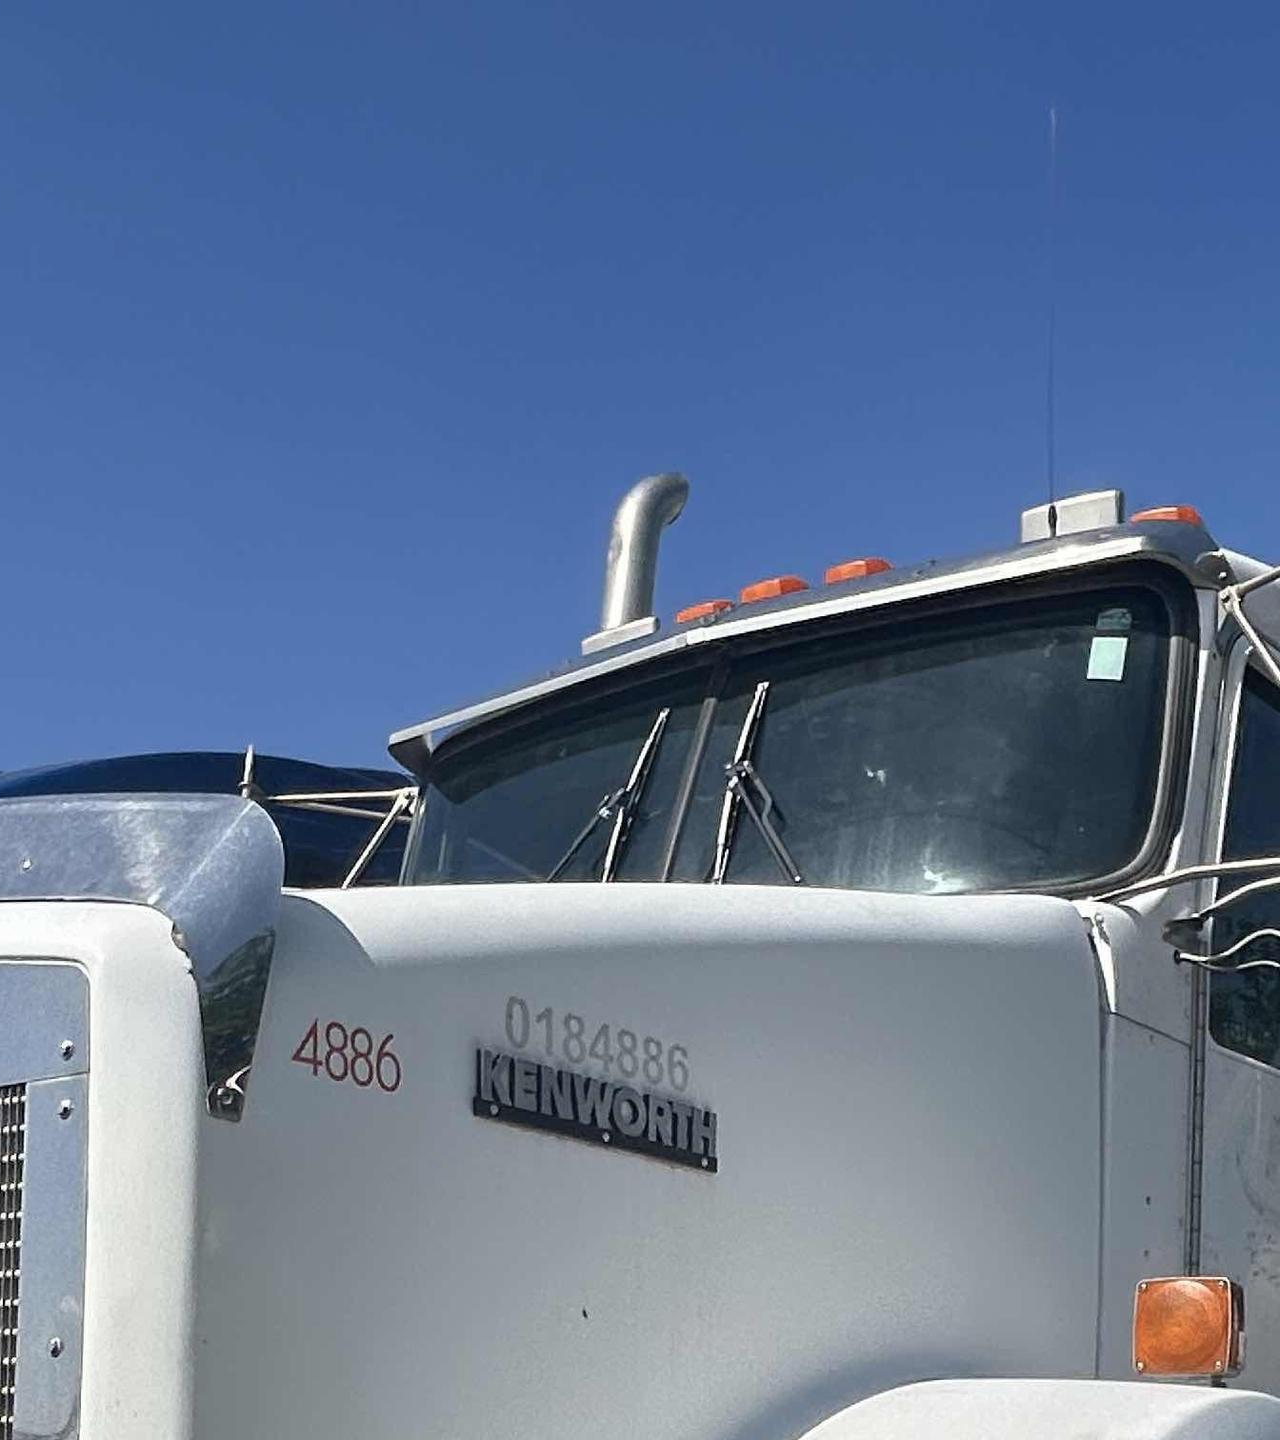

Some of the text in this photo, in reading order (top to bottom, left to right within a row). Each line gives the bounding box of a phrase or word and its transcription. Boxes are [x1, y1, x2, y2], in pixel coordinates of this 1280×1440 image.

[291, 1017, 401, 1092] 4886
[505, 996, 689, 1092] 0184886
[476, 1048, 718, 1157] KENWORTH
